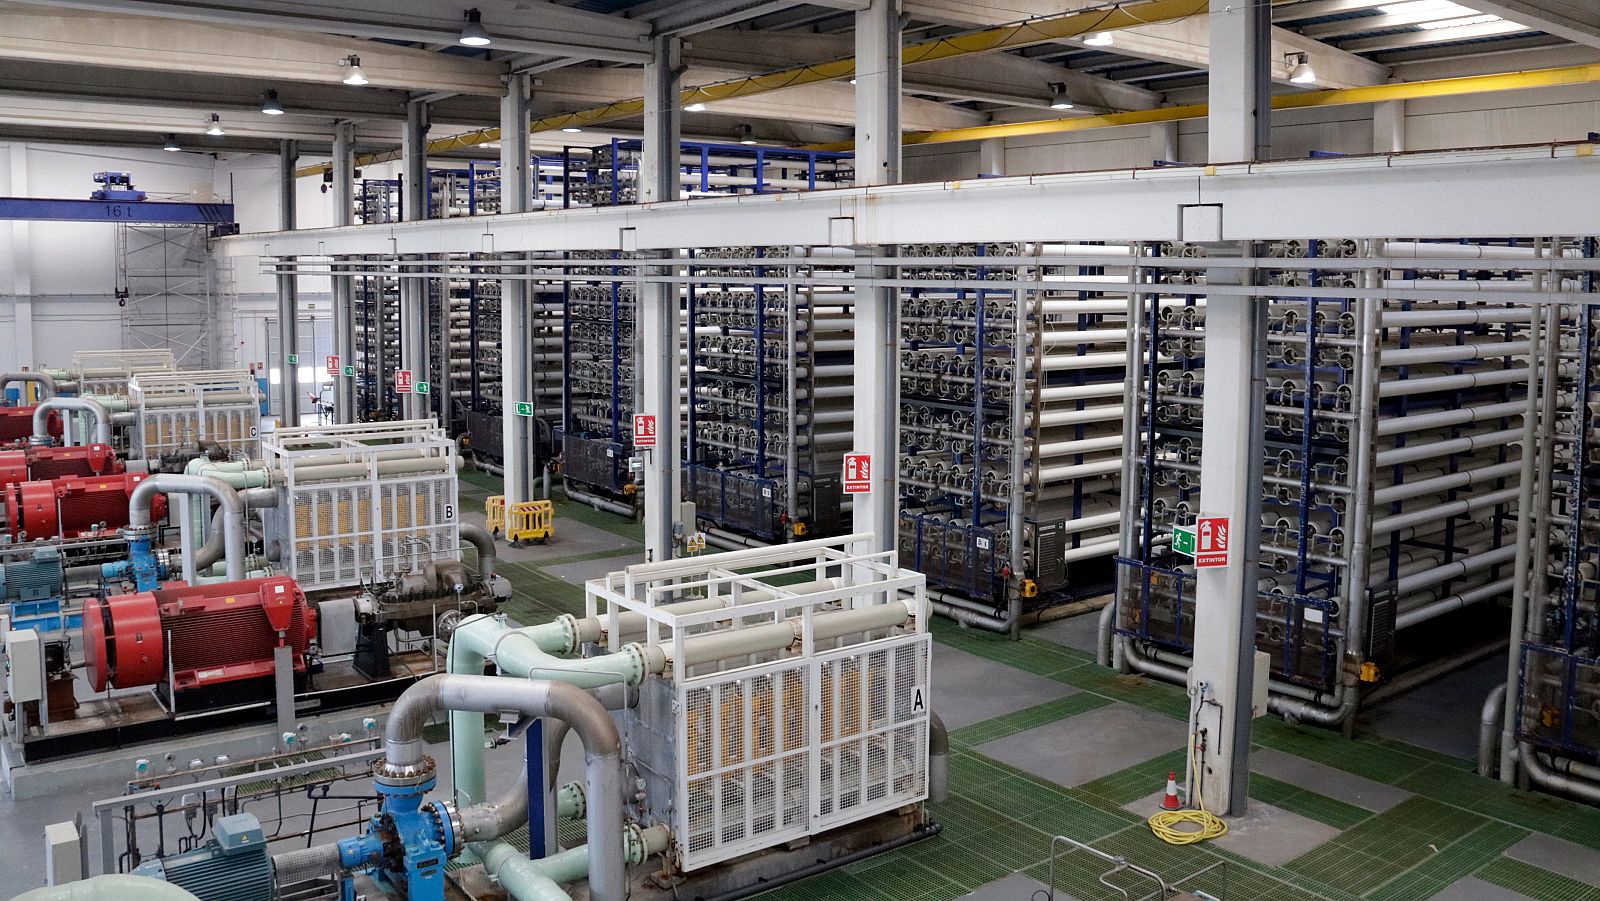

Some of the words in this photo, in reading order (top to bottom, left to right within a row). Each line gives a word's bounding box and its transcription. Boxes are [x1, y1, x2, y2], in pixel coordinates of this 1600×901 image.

[105, 205, 121, 217] 16
[127, 206, 132, 217] t
[251, 427, 257, 436] C
[446, 505, 453, 518] B
[913, 688, 924, 711] A
